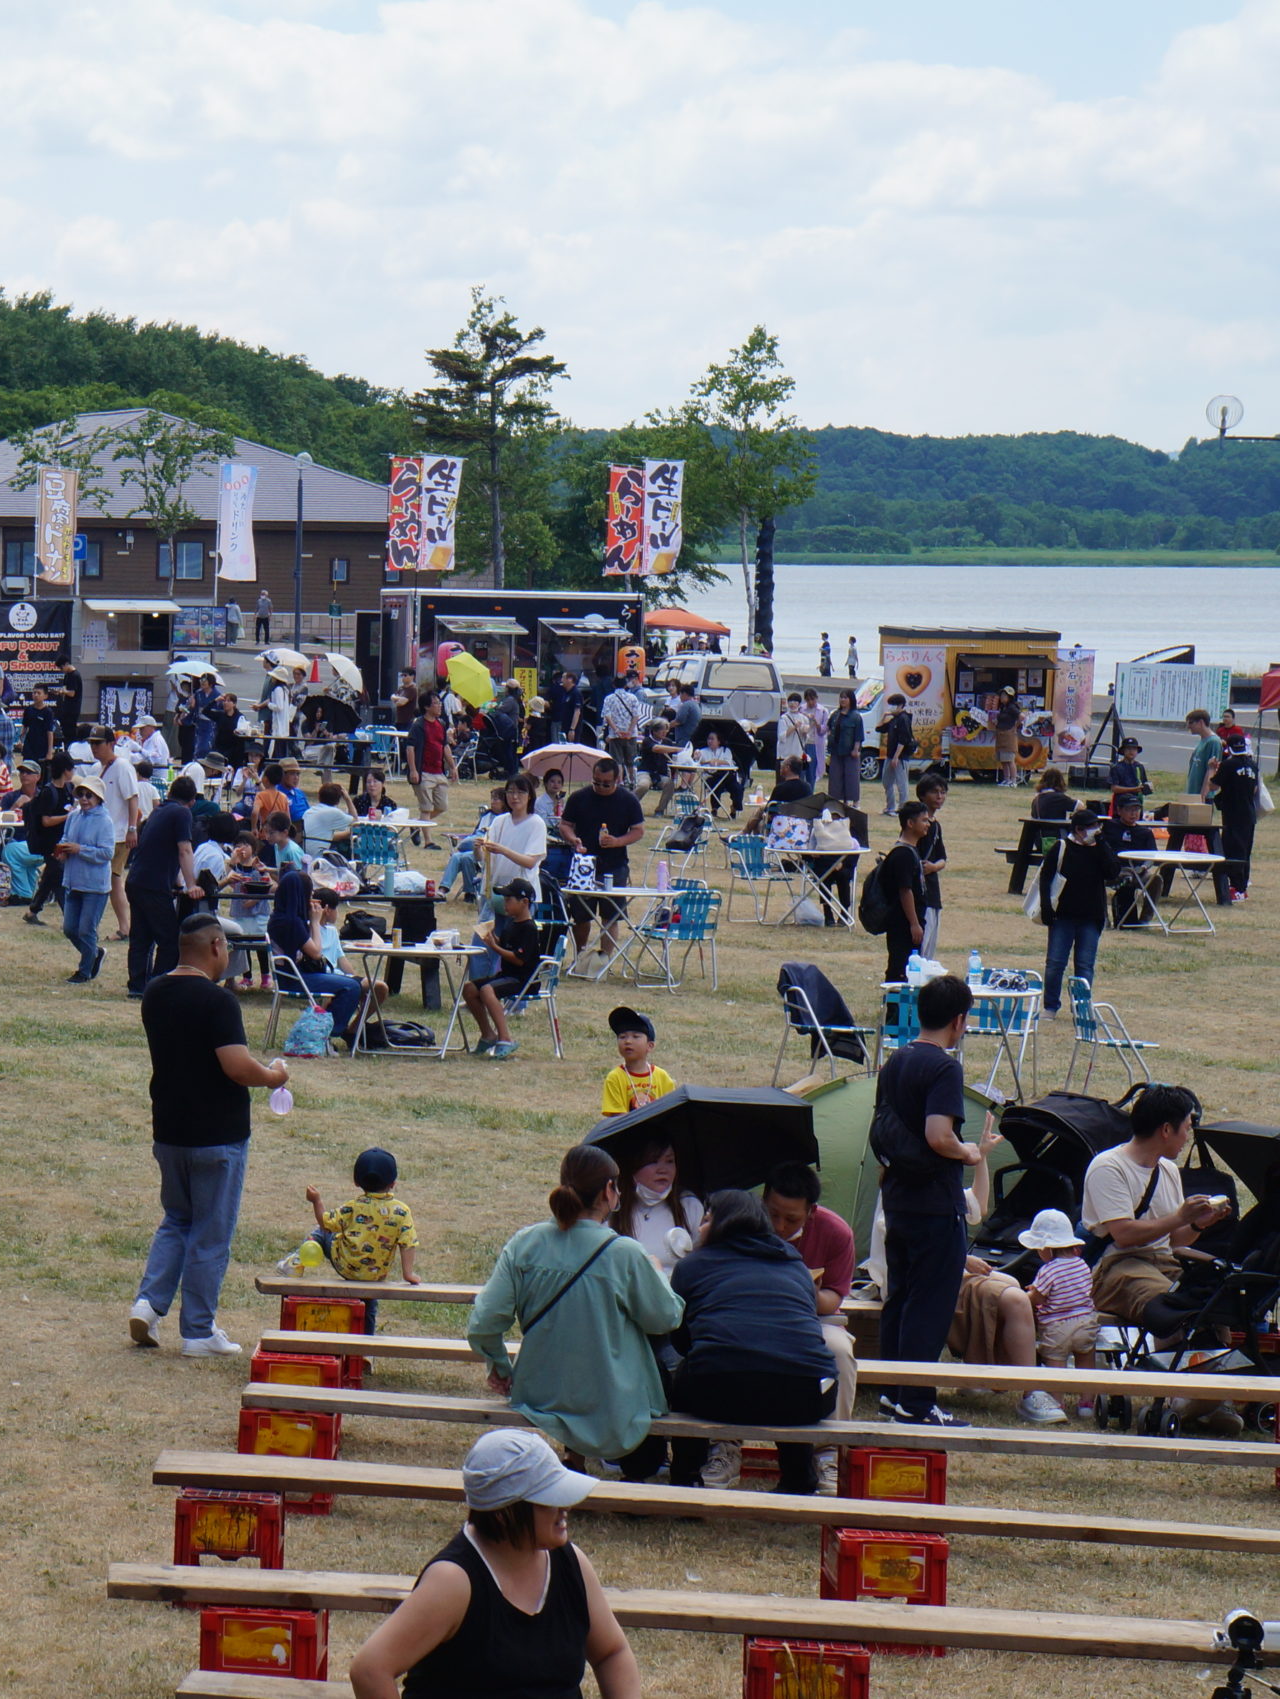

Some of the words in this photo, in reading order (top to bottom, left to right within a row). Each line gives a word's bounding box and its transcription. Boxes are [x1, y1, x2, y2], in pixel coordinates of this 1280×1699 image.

[390, 461, 422, 568] らーめん
[424, 459, 457, 544] 生ビール
[606, 470, 642, 572] らーめん
[647, 463, 680, 549] 生ビール
[18, 651, 29, 660] &
[19, 640, 60, 651] DONUT
[886, 651, 945, 663] らぶりんぐ
